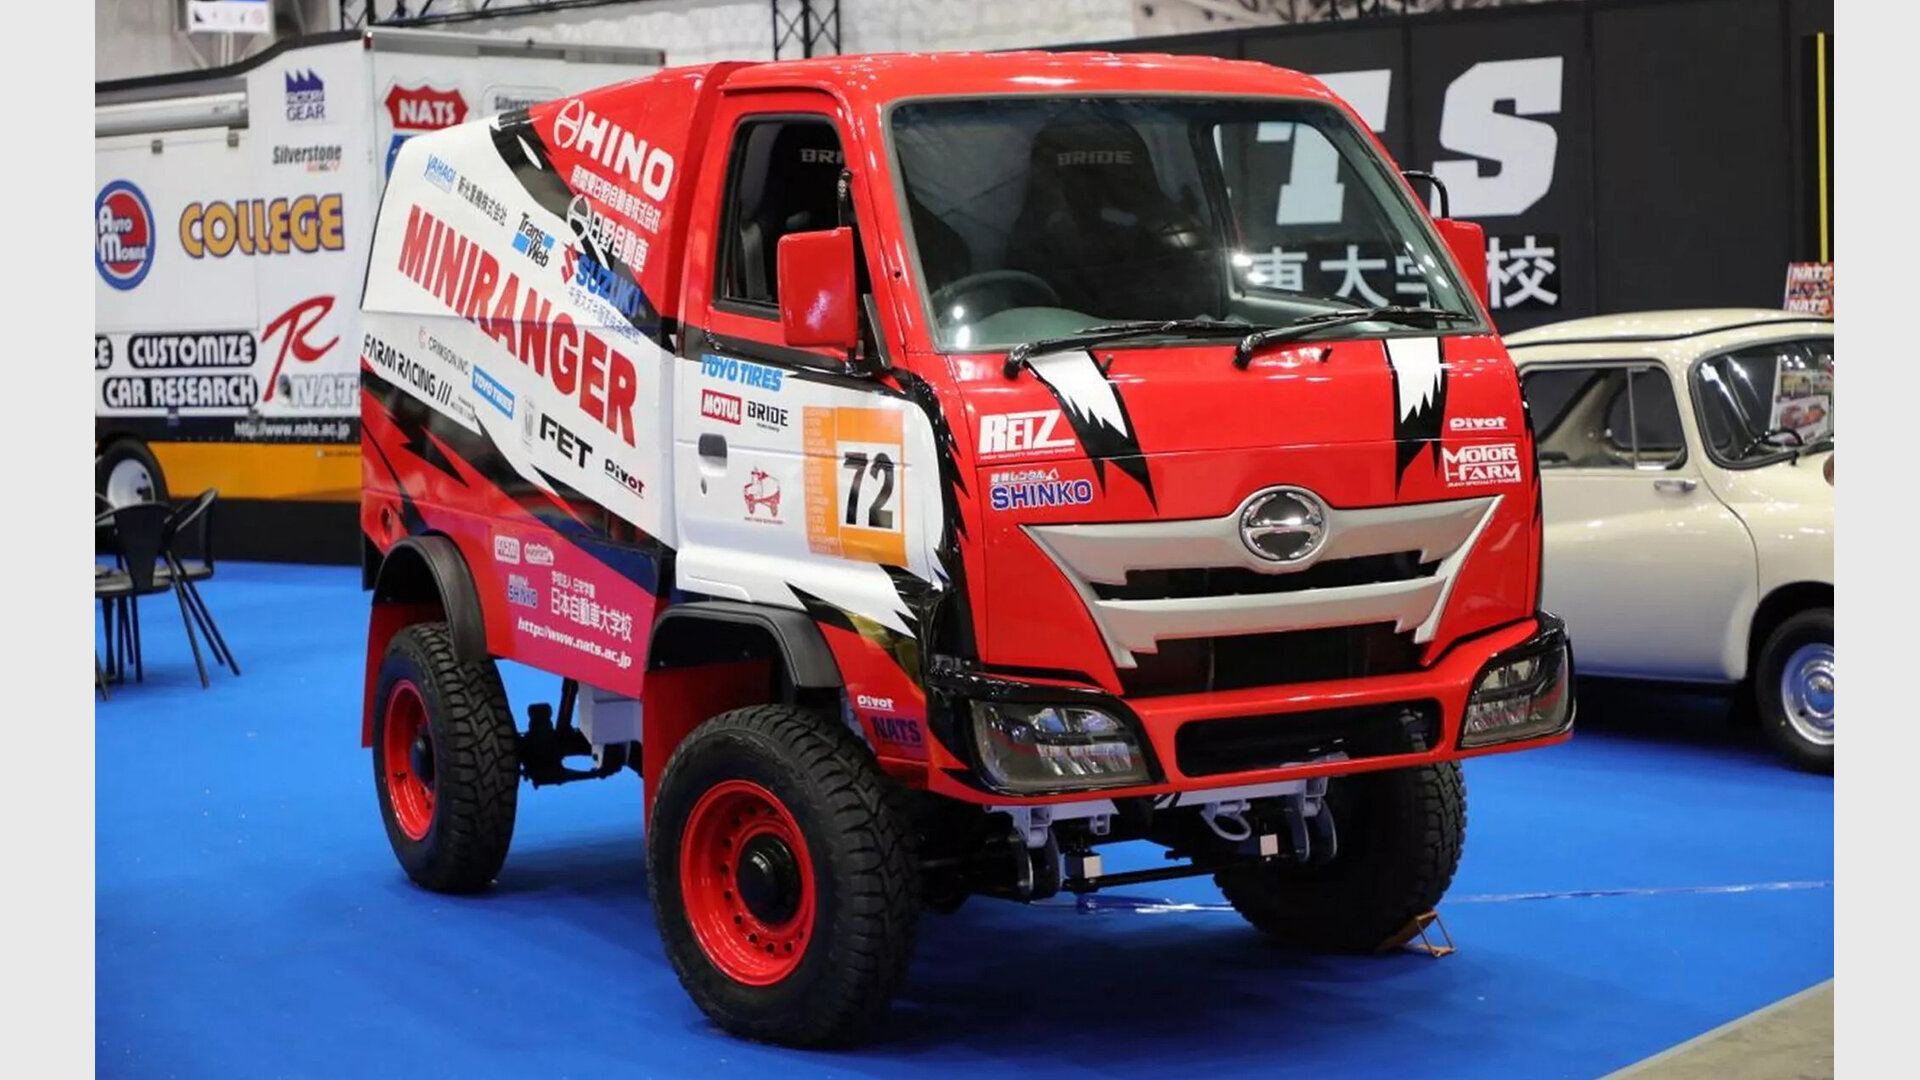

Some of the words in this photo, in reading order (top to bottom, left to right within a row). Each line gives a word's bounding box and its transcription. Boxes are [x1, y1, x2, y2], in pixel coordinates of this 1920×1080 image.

[286, 105, 325, 121] GEAR
[398, 98, 456, 125] NATS
[273, 144, 342, 165] Silverstone
[577, 111, 675, 202] HINO
[1056, 150, 1134, 167] BRIDE
[180, 193, 344, 258] COLLEGE
[519, 212, 545, 240] Trans
[588, 210, 650, 273] 日野自動車
[527, 239, 549, 267] Web
[577, 254, 641, 318] SUZUKI
[397, 204, 638, 449] MINIRANGER
[132, 335, 252, 367] CUSTOMIZE
[364, 334, 396, 370] FARM
[398, 351, 435, 397] RACING
[701, 355, 737, 382] TOYO
[739, 363, 783, 391] TIRES
[105, 377, 147, 409] CAR
[151, 375, 256, 407] RESEARCH
[289, 374, 361, 408] NAT
[703, 391, 741, 423] MOTUL
[747, 401, 788, 427] BRIDE
[540, 413, 593, 469] FET
[979, 409, 1075, 454] REIZ
[1442, 443, 1519, 469] MOTOR
[843, 452, 895, 529] 72
[1458, 464, 1521, 483] FARM
[991, 480, 1093, 510] SHINKO
[551, 587, 633, 643] 日本自動車大学校
[518, 616, 633, 670] http://www.nats.ac.jp
[871, 716, 923, 744] NATS
